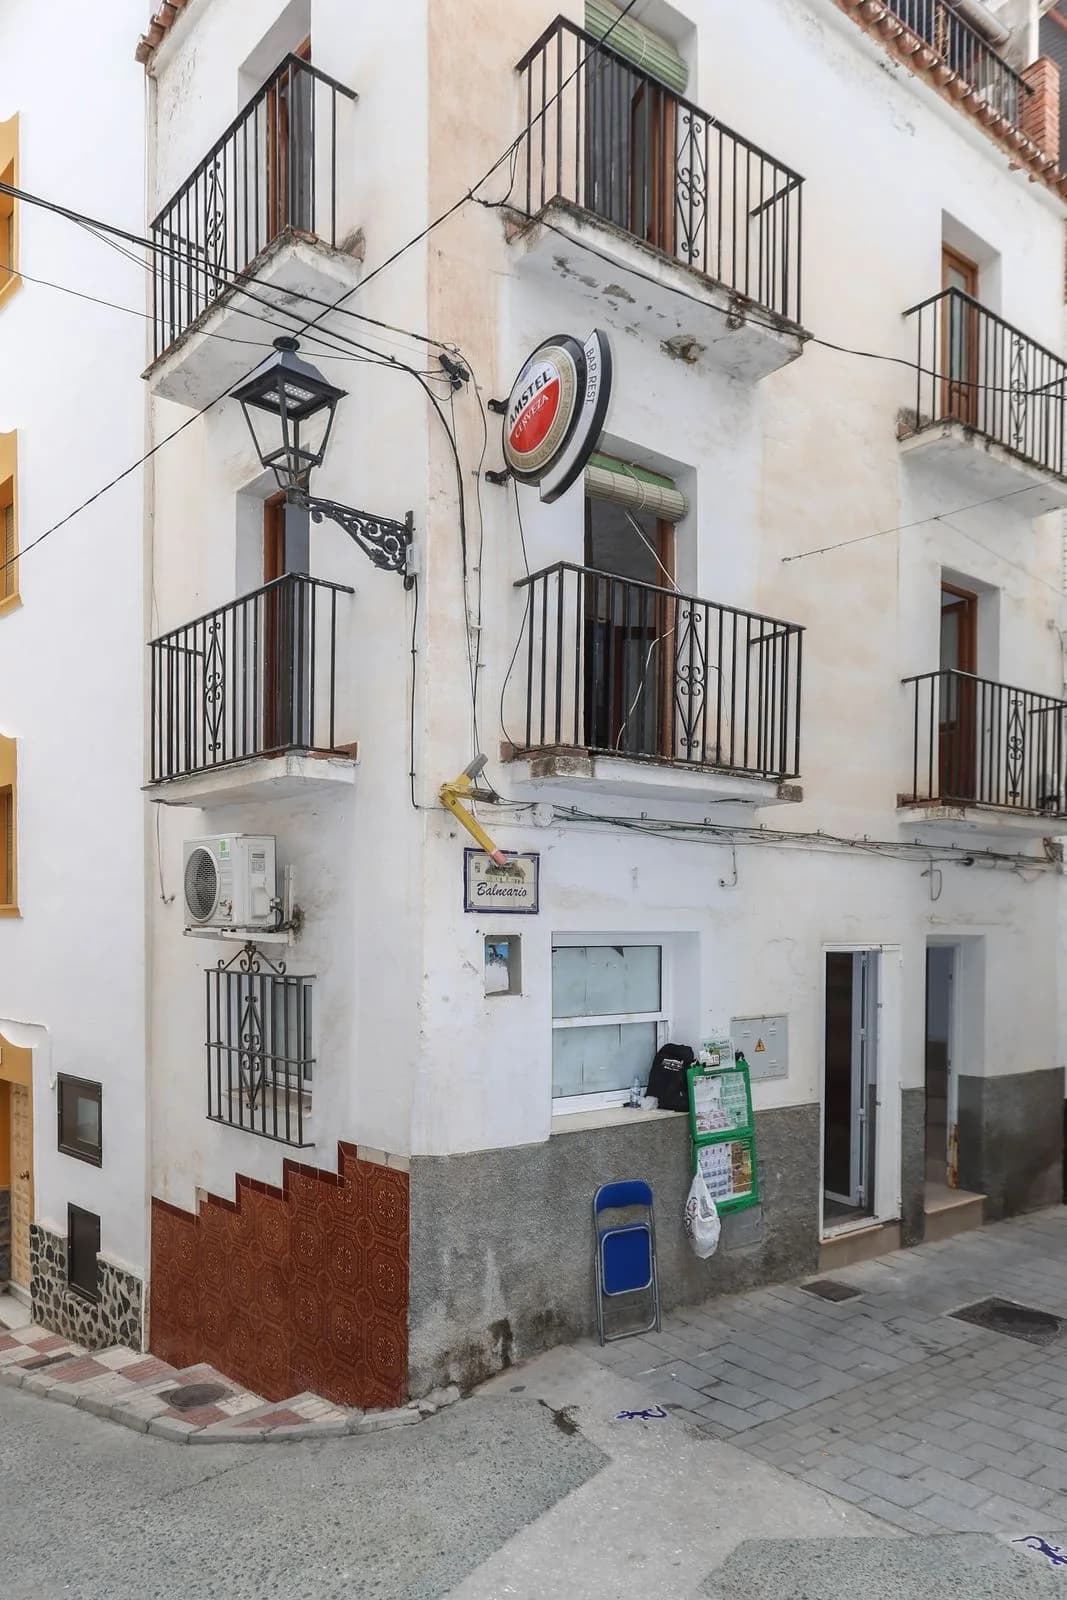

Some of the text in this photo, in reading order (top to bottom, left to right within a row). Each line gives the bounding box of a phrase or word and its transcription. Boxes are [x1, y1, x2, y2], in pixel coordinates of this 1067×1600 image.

[509, 371, 552, 427] AMSTEL
[585, 347, 598, 405] BAR REST.
[514, 394, 549, 438] CERVEZA
[477, 882, 527, 897] Balneario
